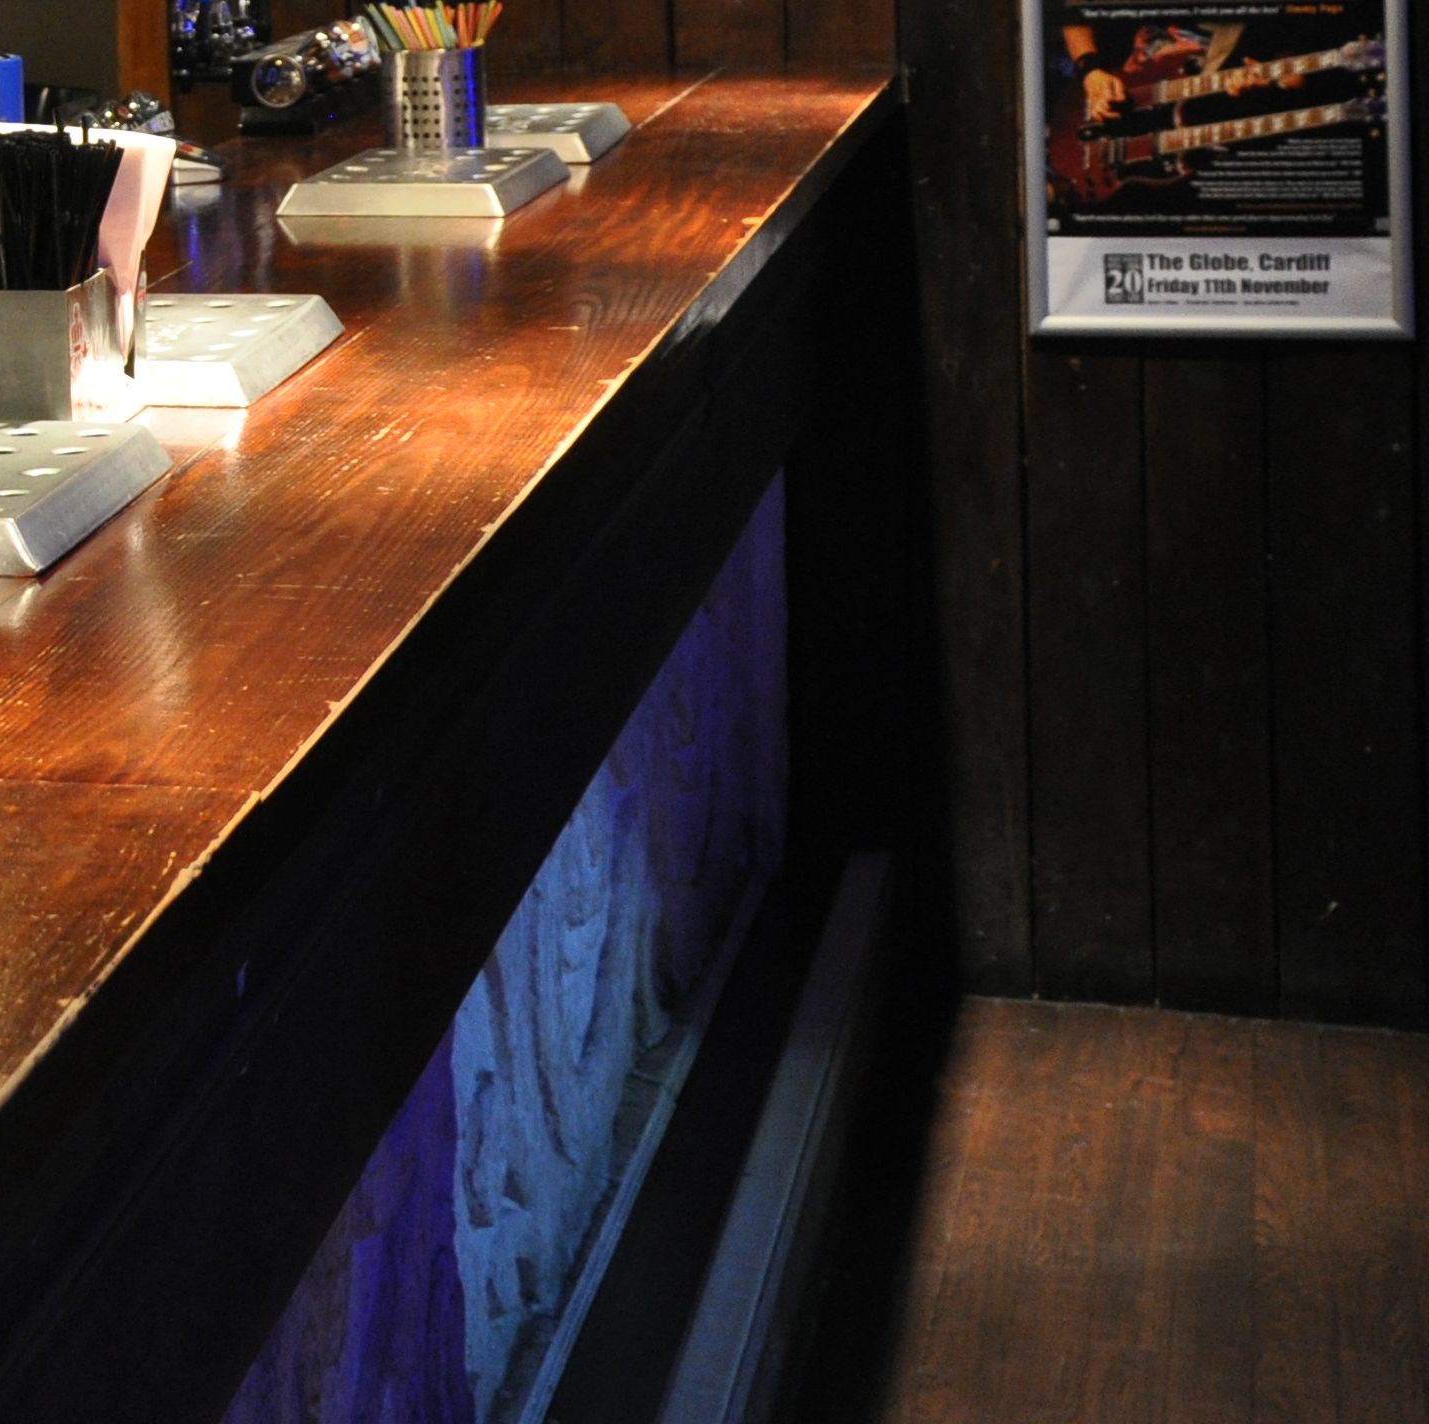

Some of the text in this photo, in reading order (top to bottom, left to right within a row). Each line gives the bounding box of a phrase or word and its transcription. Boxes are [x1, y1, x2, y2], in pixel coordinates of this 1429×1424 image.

[1146, 252, 1184, 272] The
[1258, 252, 1331, 273] Cardiff
[1146, 276, 1330, 296] Friday 11th November
